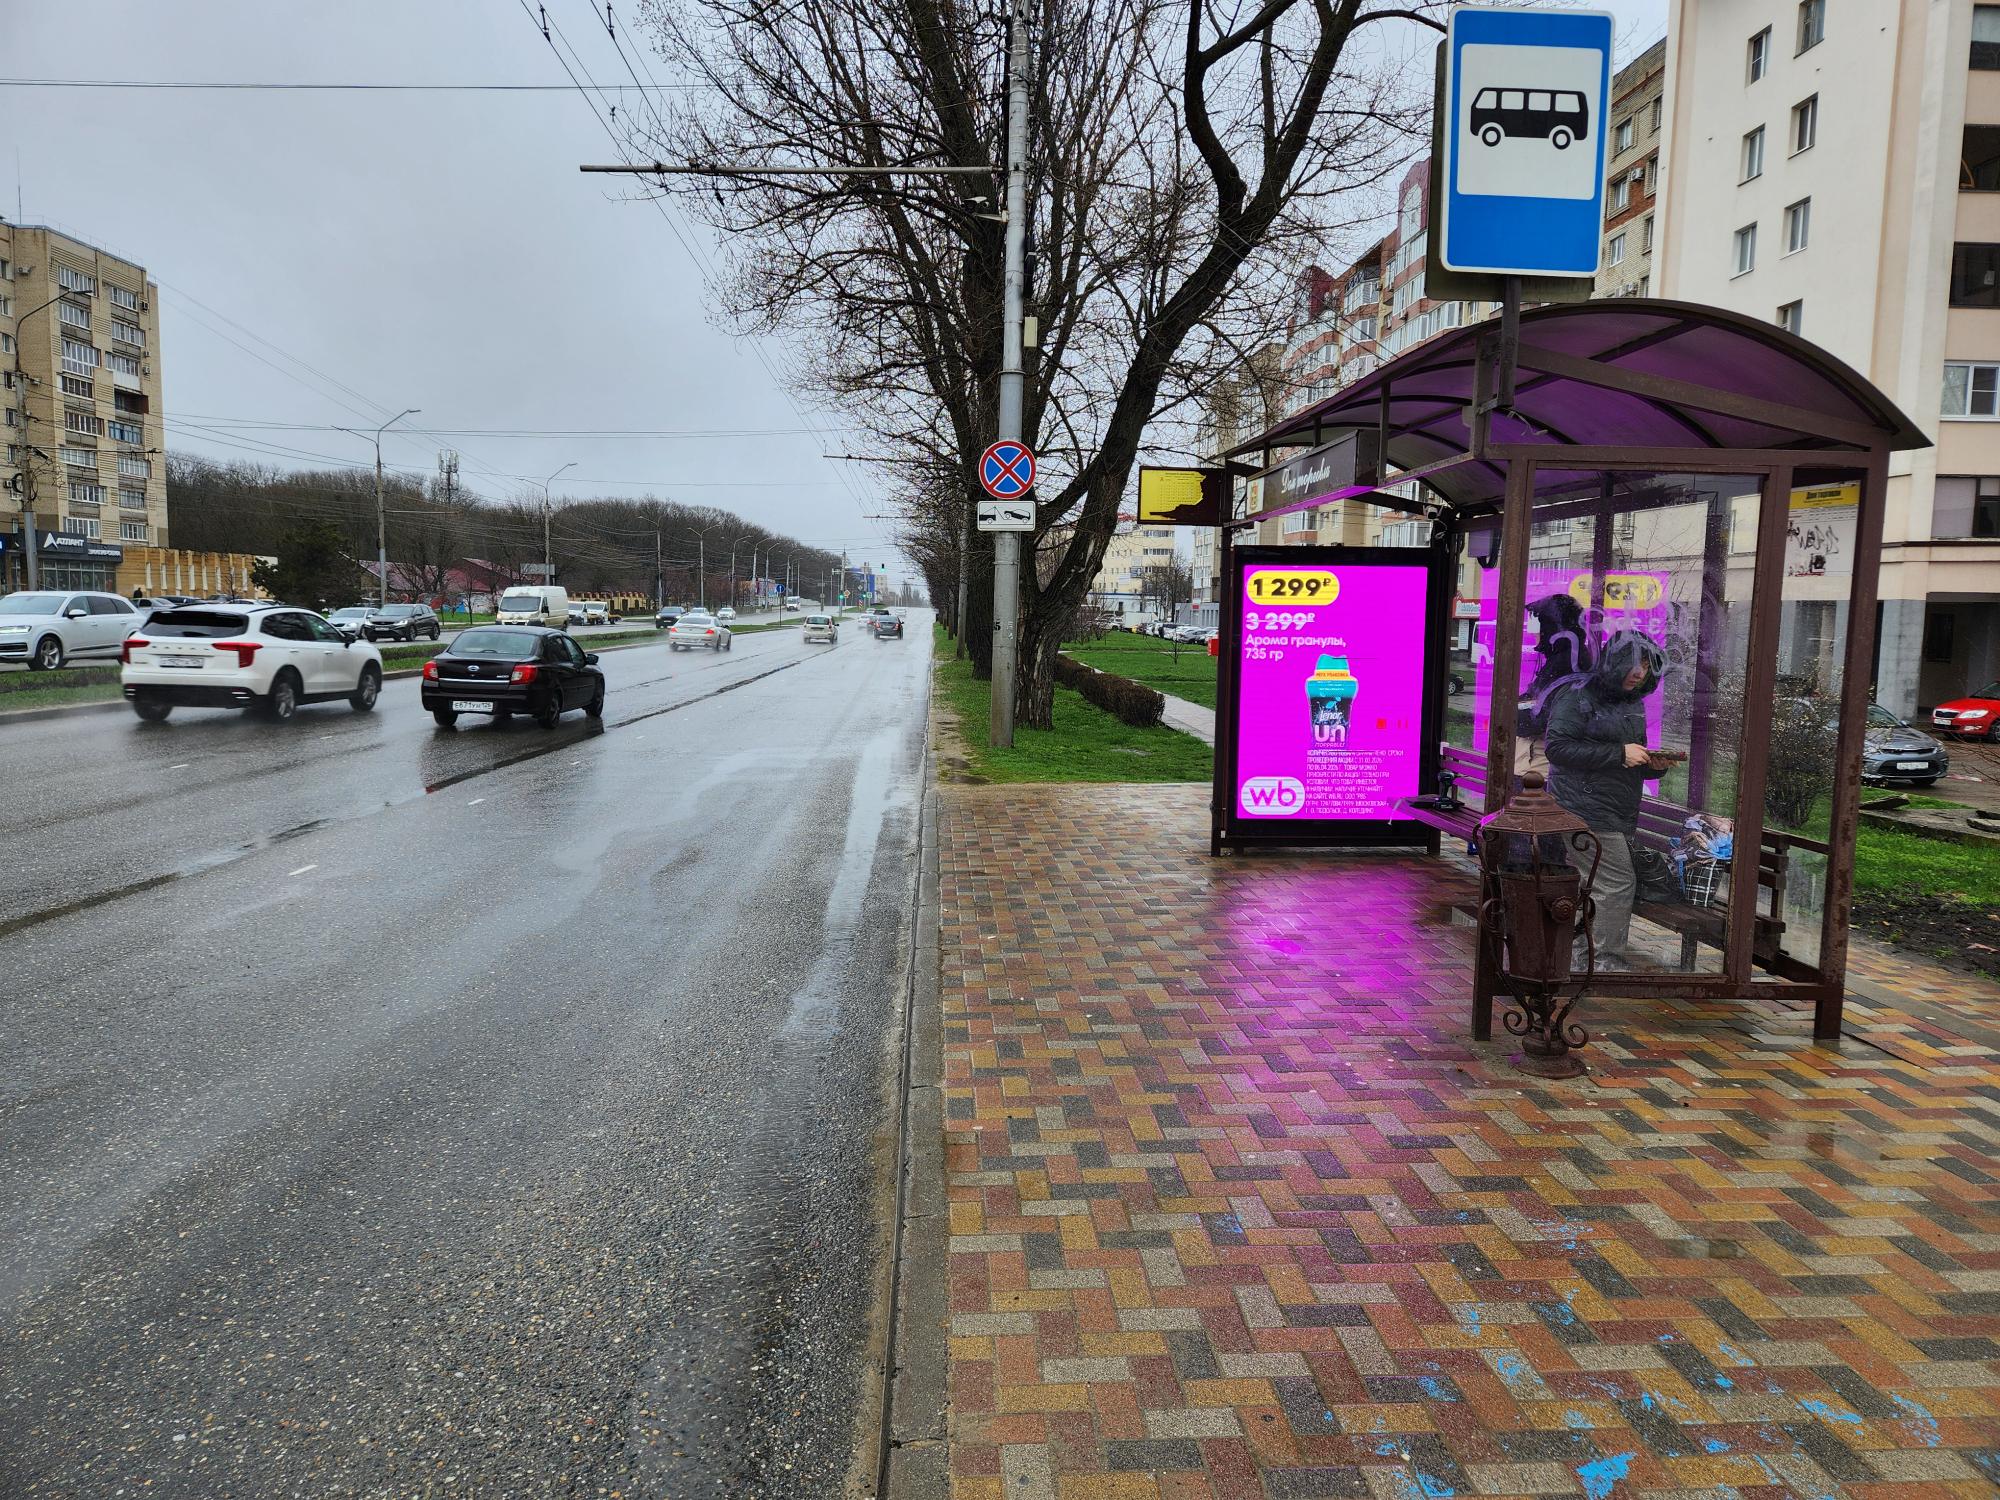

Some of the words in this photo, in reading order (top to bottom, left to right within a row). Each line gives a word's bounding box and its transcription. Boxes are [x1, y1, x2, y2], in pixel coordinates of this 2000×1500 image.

[1244, 634, 1289, 648] Арома
[1291, 636, 1347, 648] гранулы,
[1245, 647, 1267, 660] 735
[1268, 650, 1285, 662] гр
[1249, 779, 1297, 807] wb
